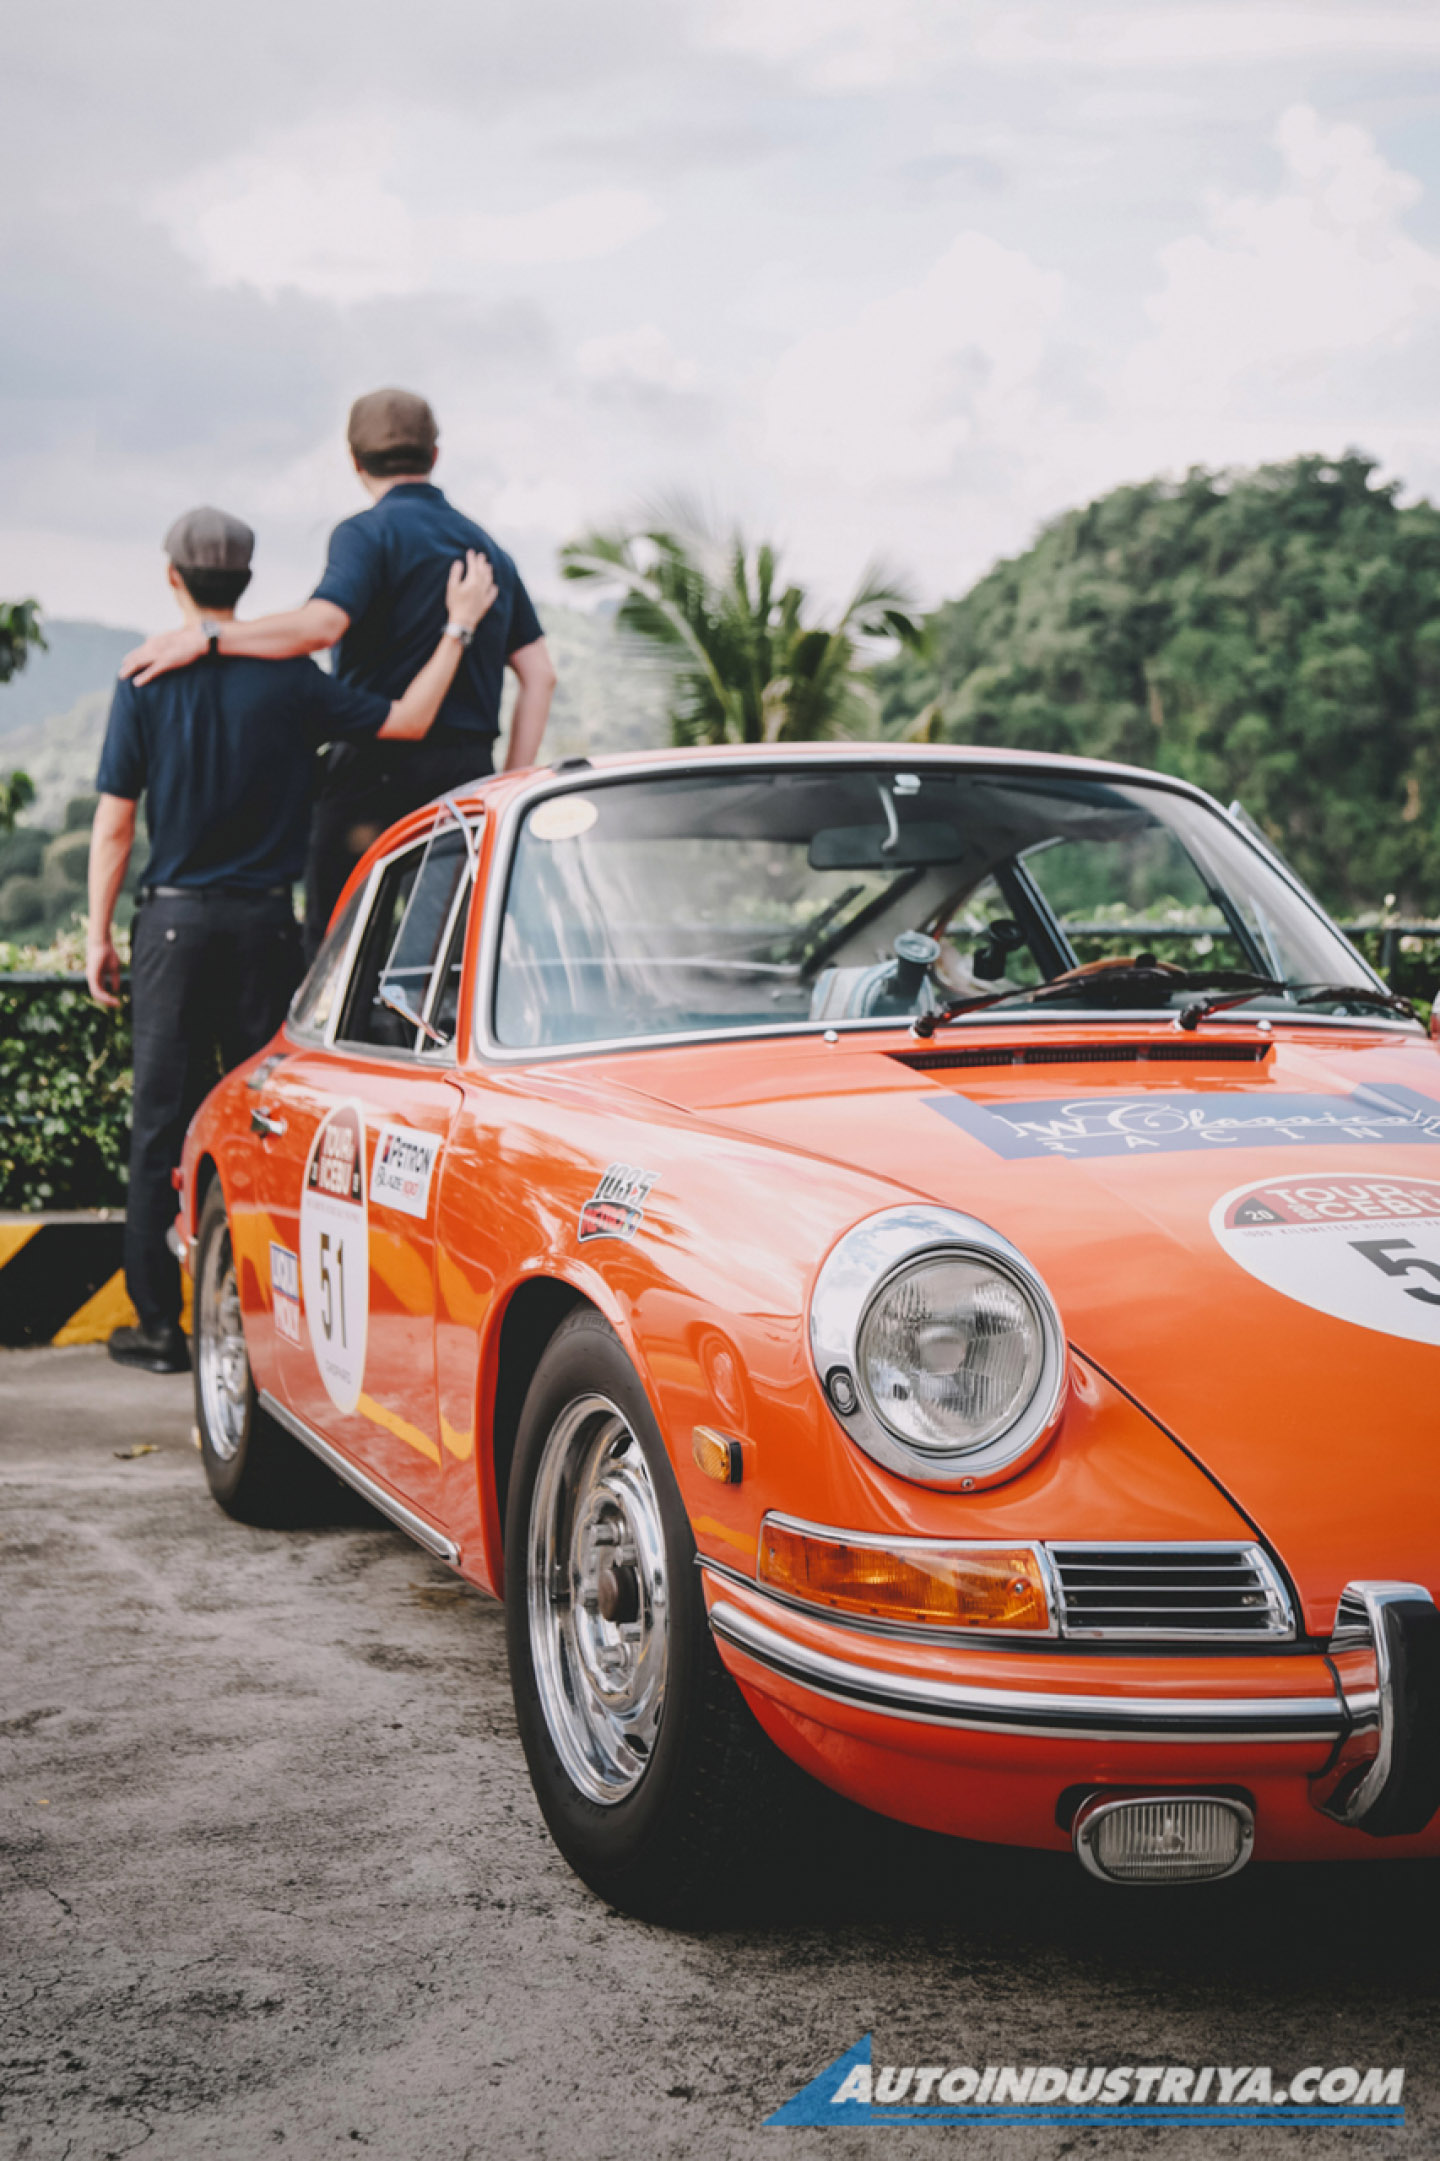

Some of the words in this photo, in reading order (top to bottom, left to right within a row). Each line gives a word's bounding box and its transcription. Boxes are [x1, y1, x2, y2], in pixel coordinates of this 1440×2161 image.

[391, 1137, 434, 1176] PETRON
[1264, 1184, 1413, 1204] TOUR
[1245, 1210, 1275, 1222] 20
[320, 1232, 347, 1349] 51
